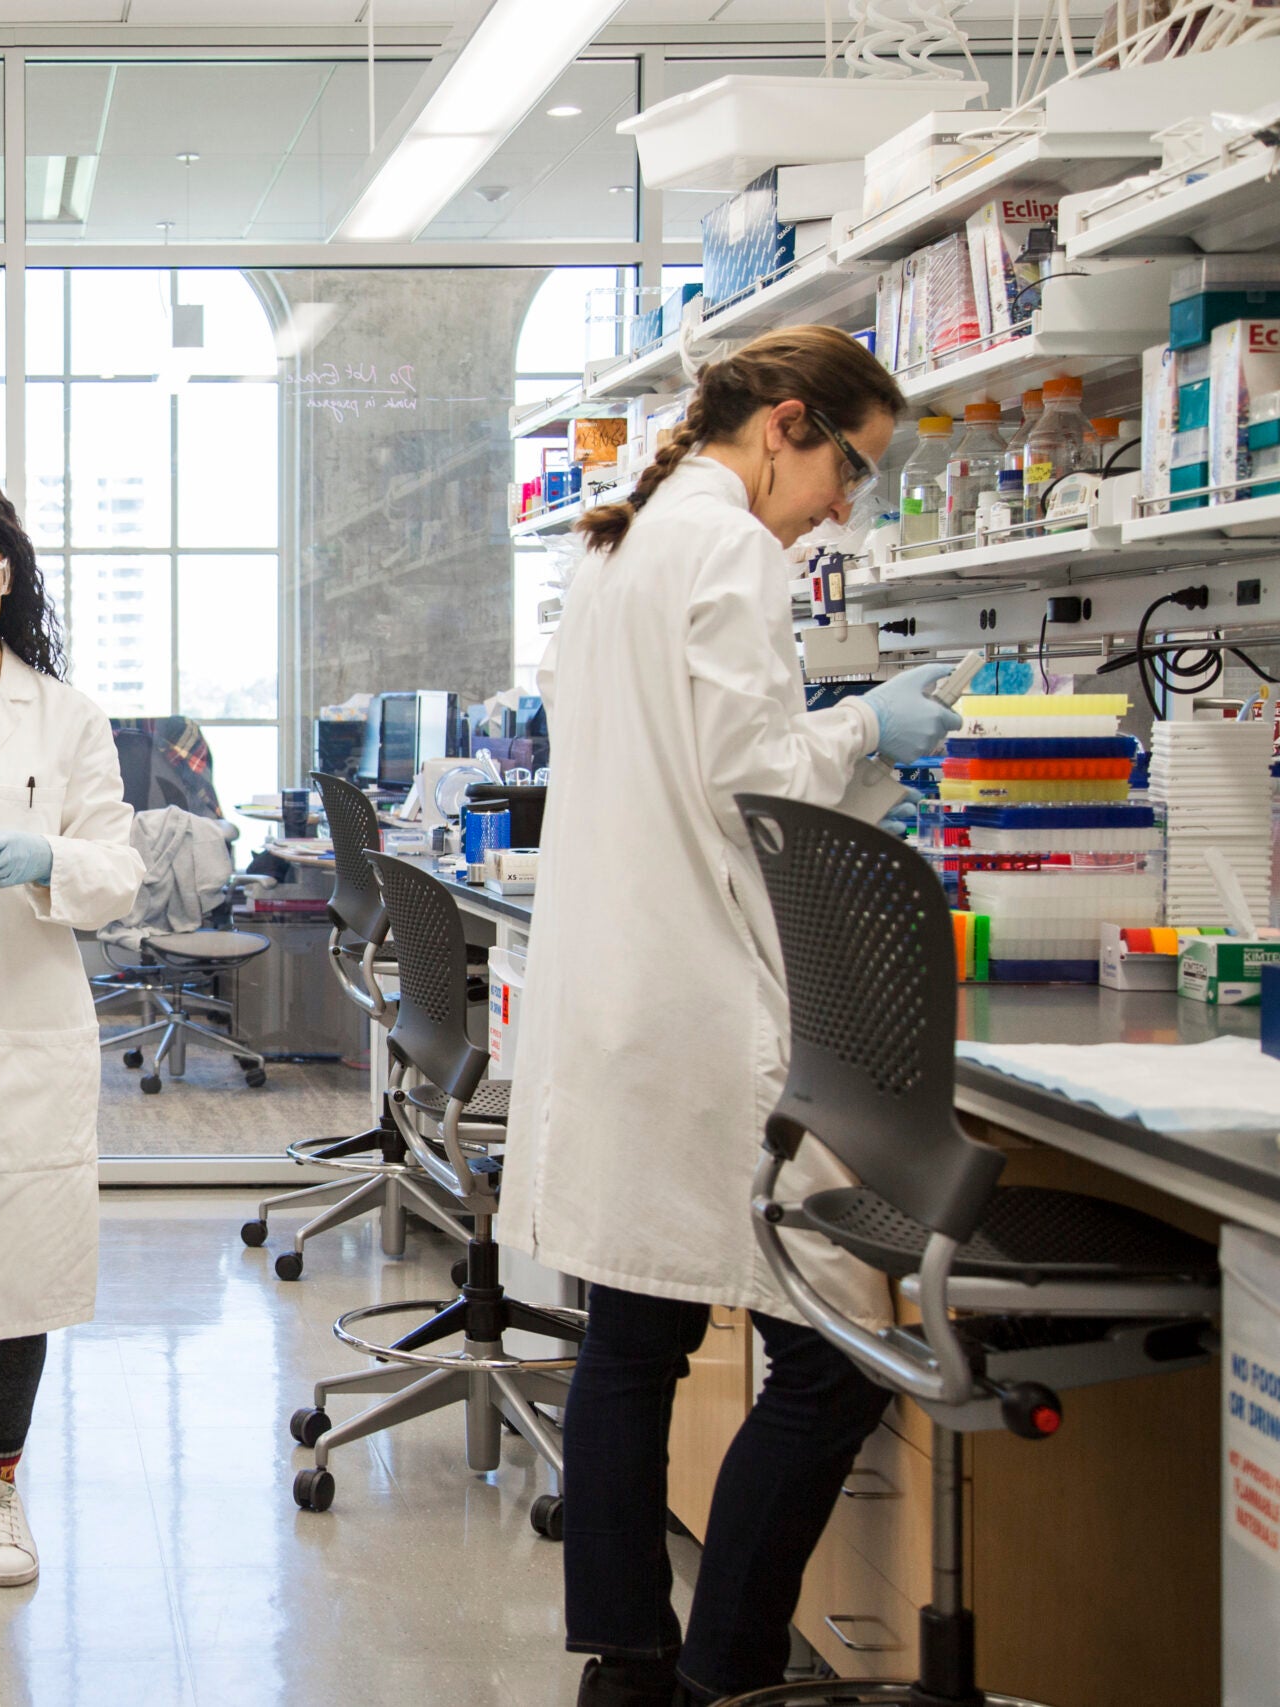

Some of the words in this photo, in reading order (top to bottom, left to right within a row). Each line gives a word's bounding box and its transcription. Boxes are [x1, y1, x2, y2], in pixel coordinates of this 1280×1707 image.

[1244, 952, 1280, 961] KIMTE
[1231, 1353, 1248, 1383] NO
[1248, 1401, 1280, 1442] DRIN
